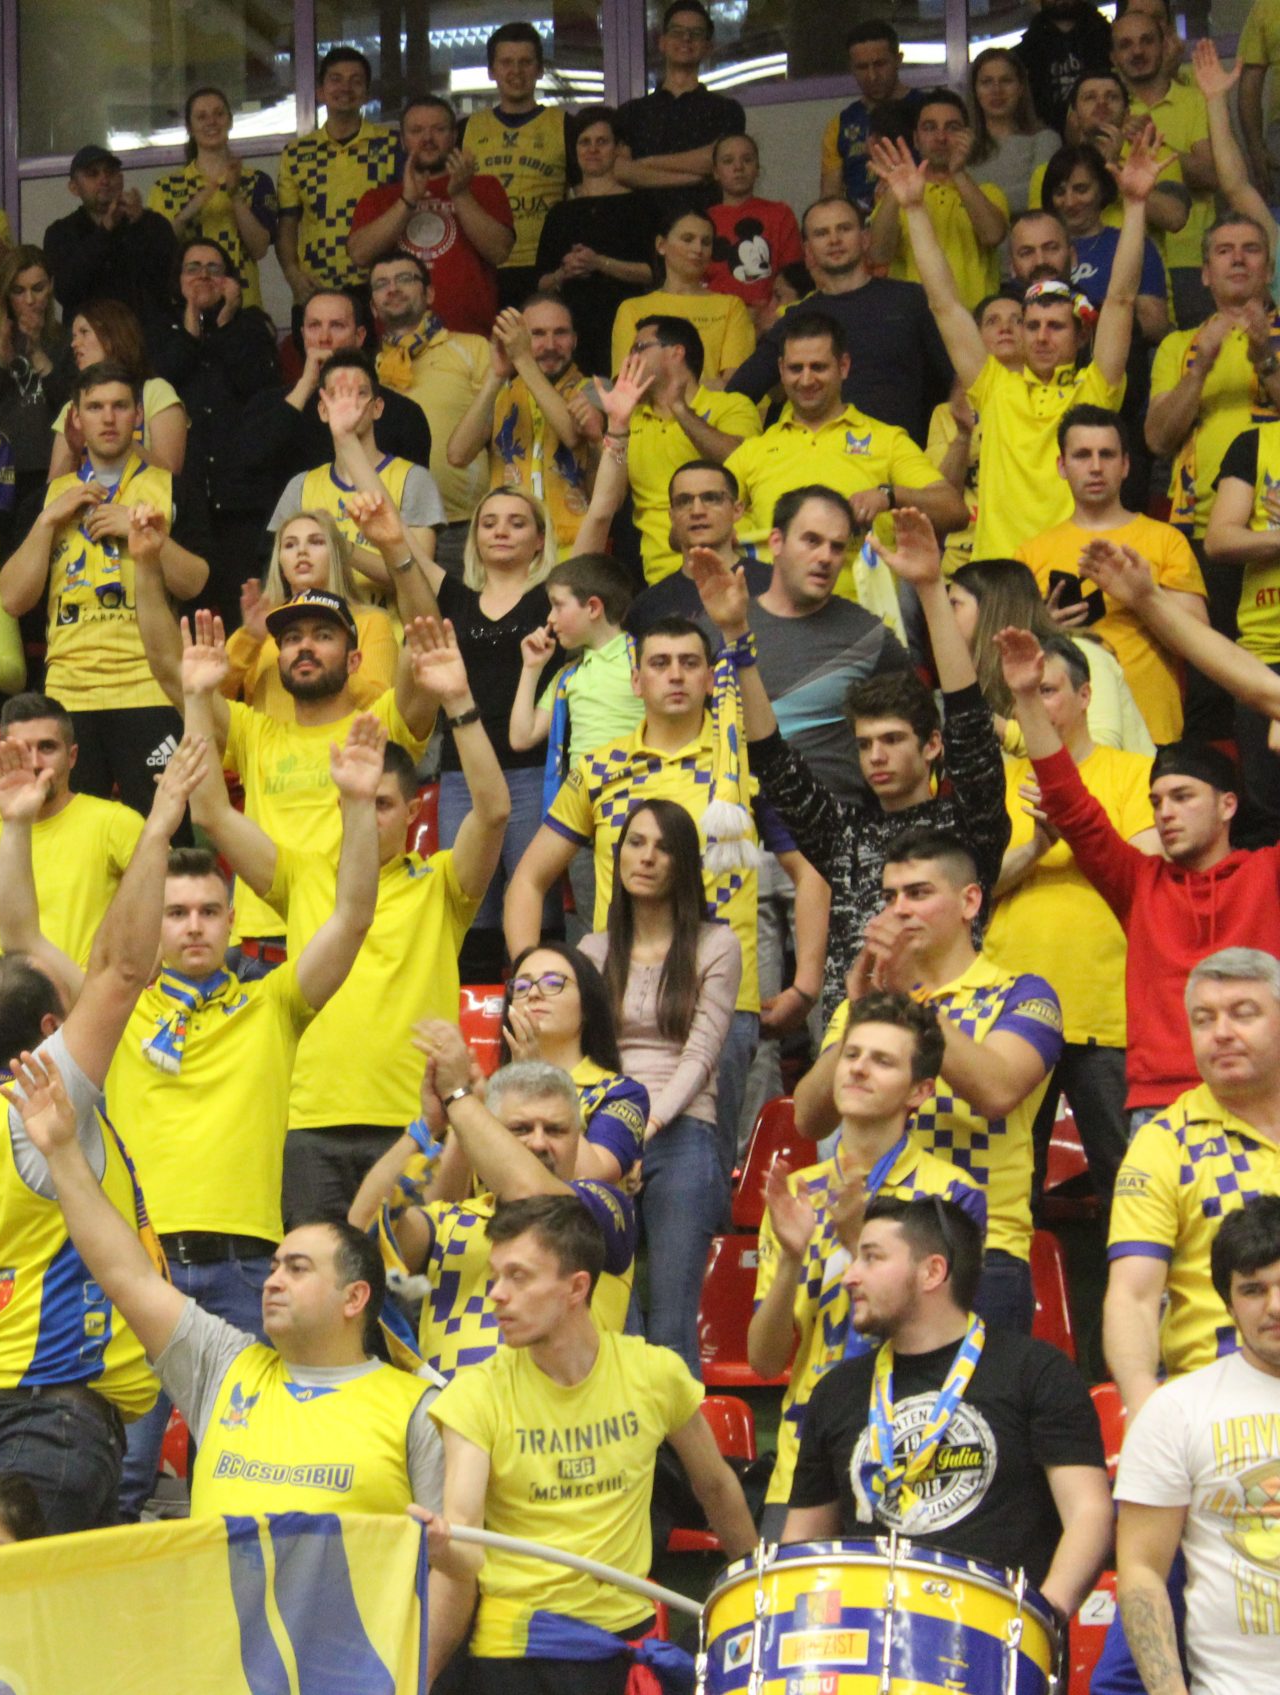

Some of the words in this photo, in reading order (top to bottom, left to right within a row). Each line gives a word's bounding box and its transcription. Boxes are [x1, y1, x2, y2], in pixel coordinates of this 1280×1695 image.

[304, 594, 340, 609] LAKERS
[516, 1411, 639, 1455] TRAINING
[215, 1452, 243, 1477] BC
[244, 1461, 288, 1483] CSU
[291, 1465, 353, 1491] SIBIU
[560, 1458, 594, 1478] REG
[1091, 1599, 1107, 1617] 2
